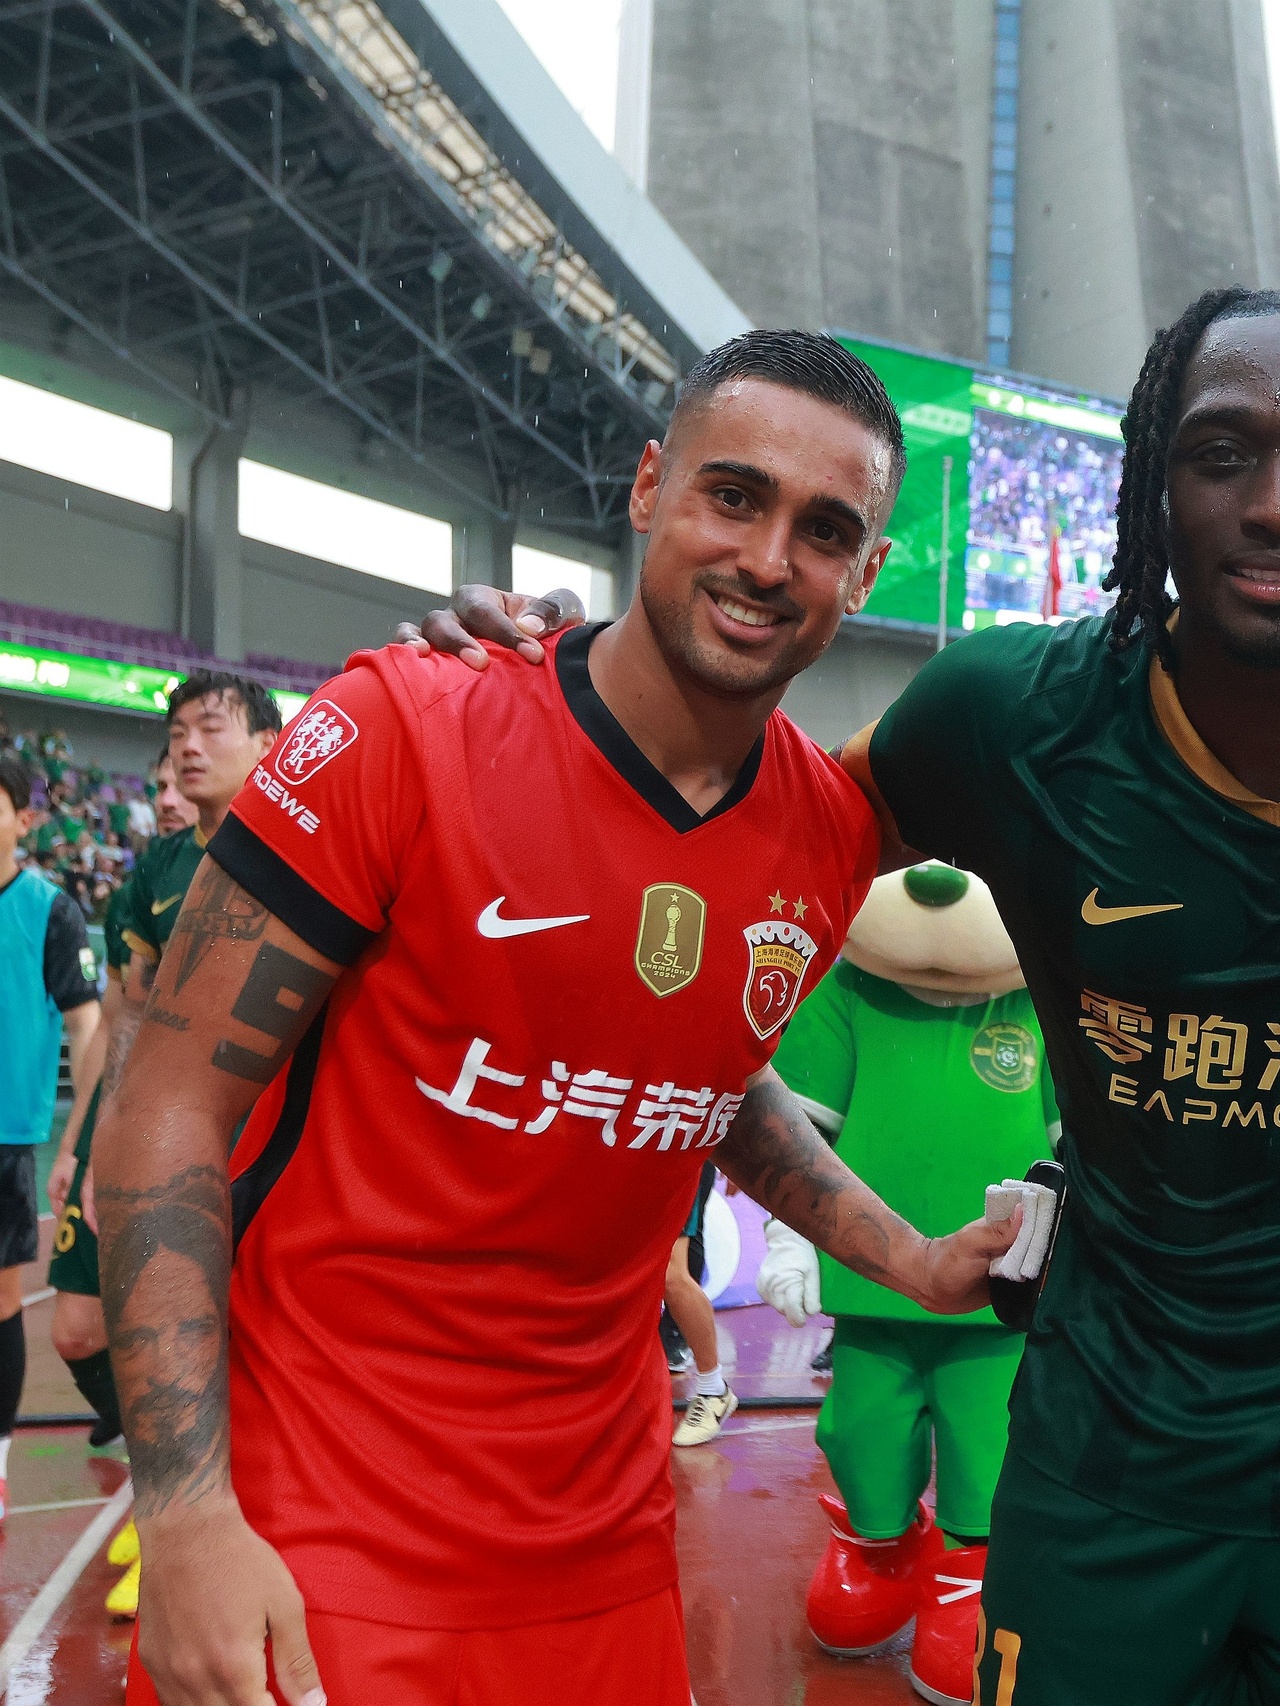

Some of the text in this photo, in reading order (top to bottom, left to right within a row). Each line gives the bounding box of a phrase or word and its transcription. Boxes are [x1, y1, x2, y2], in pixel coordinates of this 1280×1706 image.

[650, 951, 684, 969] CSL
[640, 962, 691, 977] CHAMPIONS
[653, 970, 676, 979] 2024
